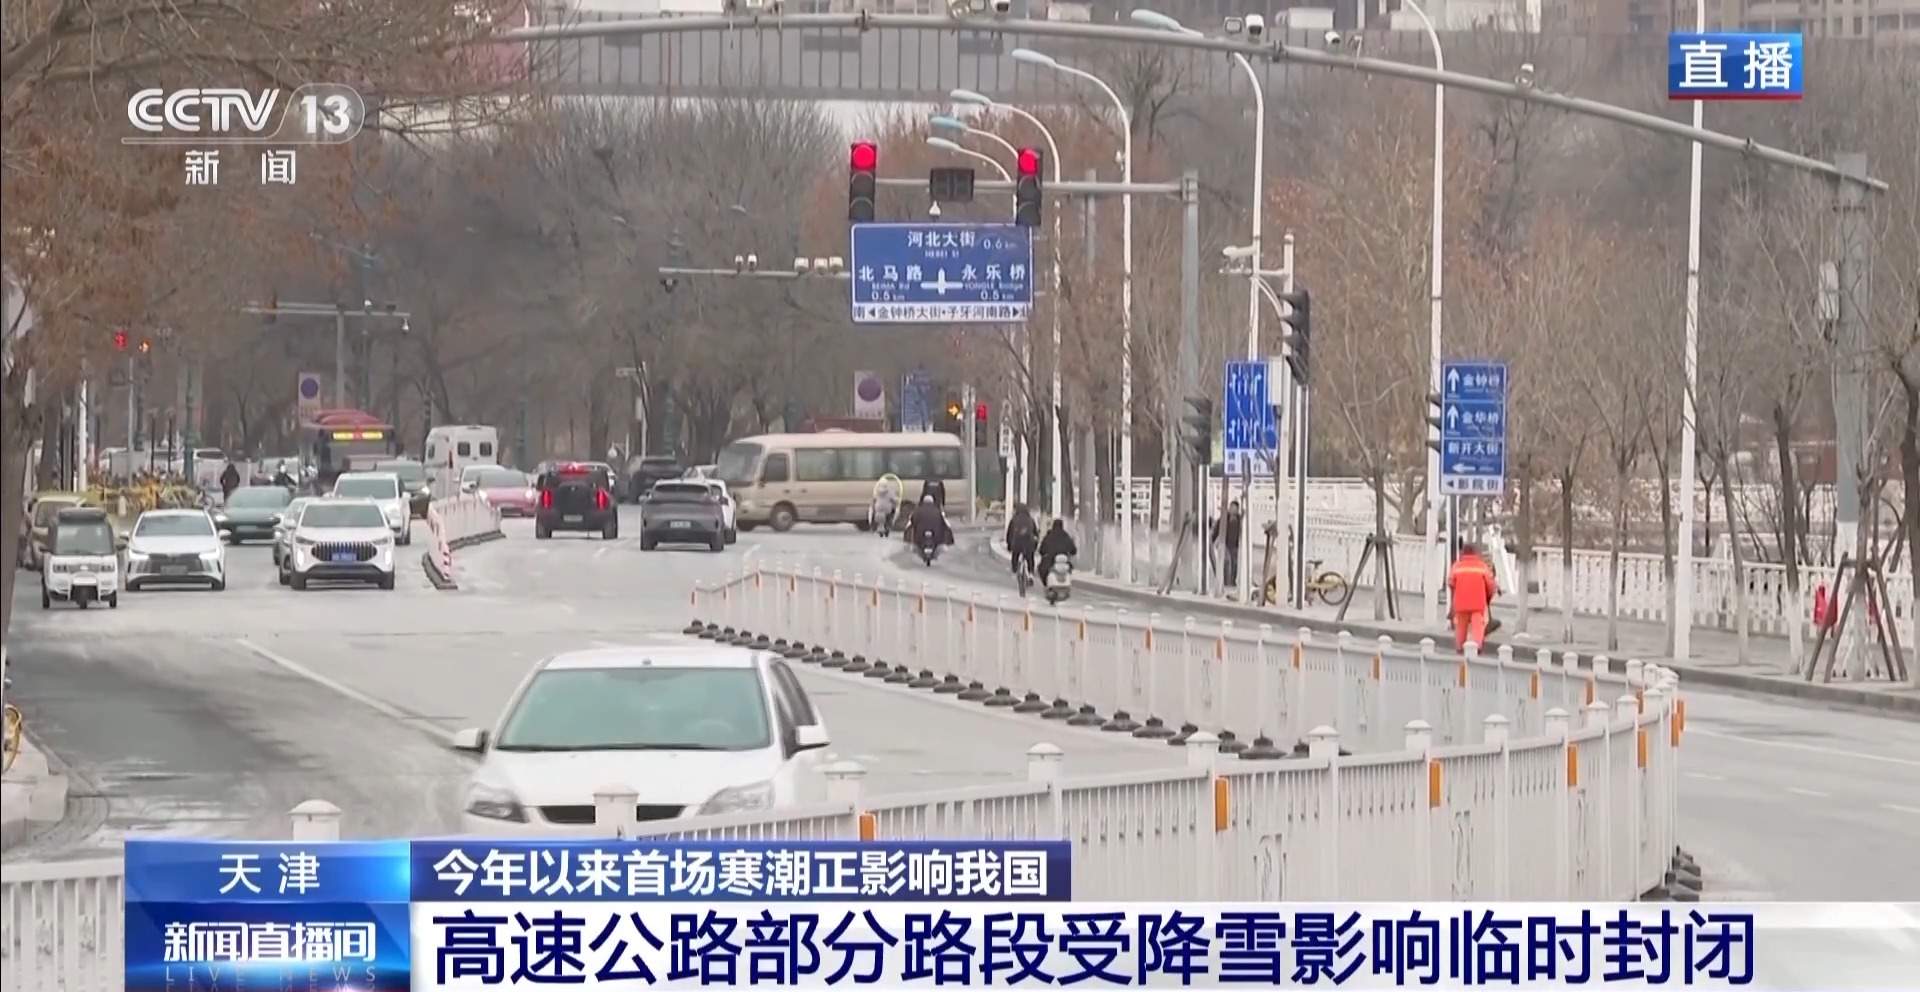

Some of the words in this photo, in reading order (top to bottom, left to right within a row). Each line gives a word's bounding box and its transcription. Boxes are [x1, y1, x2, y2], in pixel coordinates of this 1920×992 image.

[907, 231, 975, 248] 河北大街
[983, 238, 1002, 249] 0.6
[858, 265, 922, 282] 北马路
[961, 263, 1025, 280] 永乐桥
